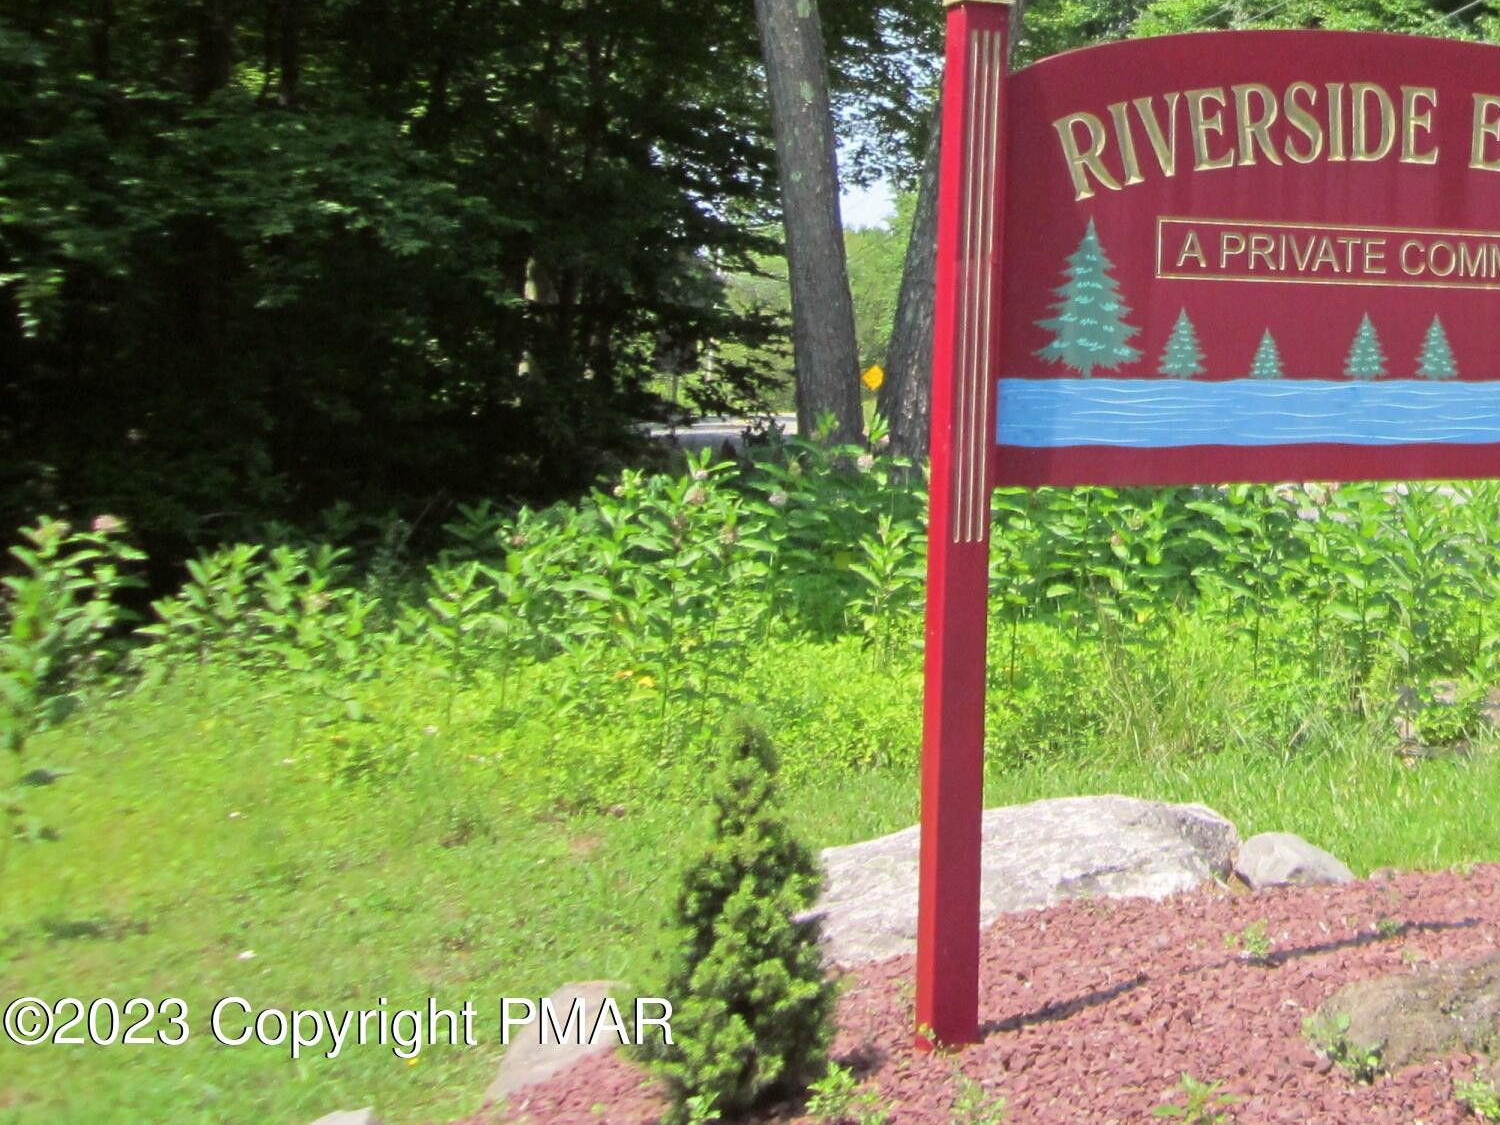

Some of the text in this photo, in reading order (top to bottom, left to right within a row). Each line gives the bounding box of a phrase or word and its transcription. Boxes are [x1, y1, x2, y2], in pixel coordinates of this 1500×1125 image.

[1053, 81, 1439, 202] RIVERSIDE
[1177, 231, 1206, 268] A
[1220, 232, 1387, 275] PRIVATE
